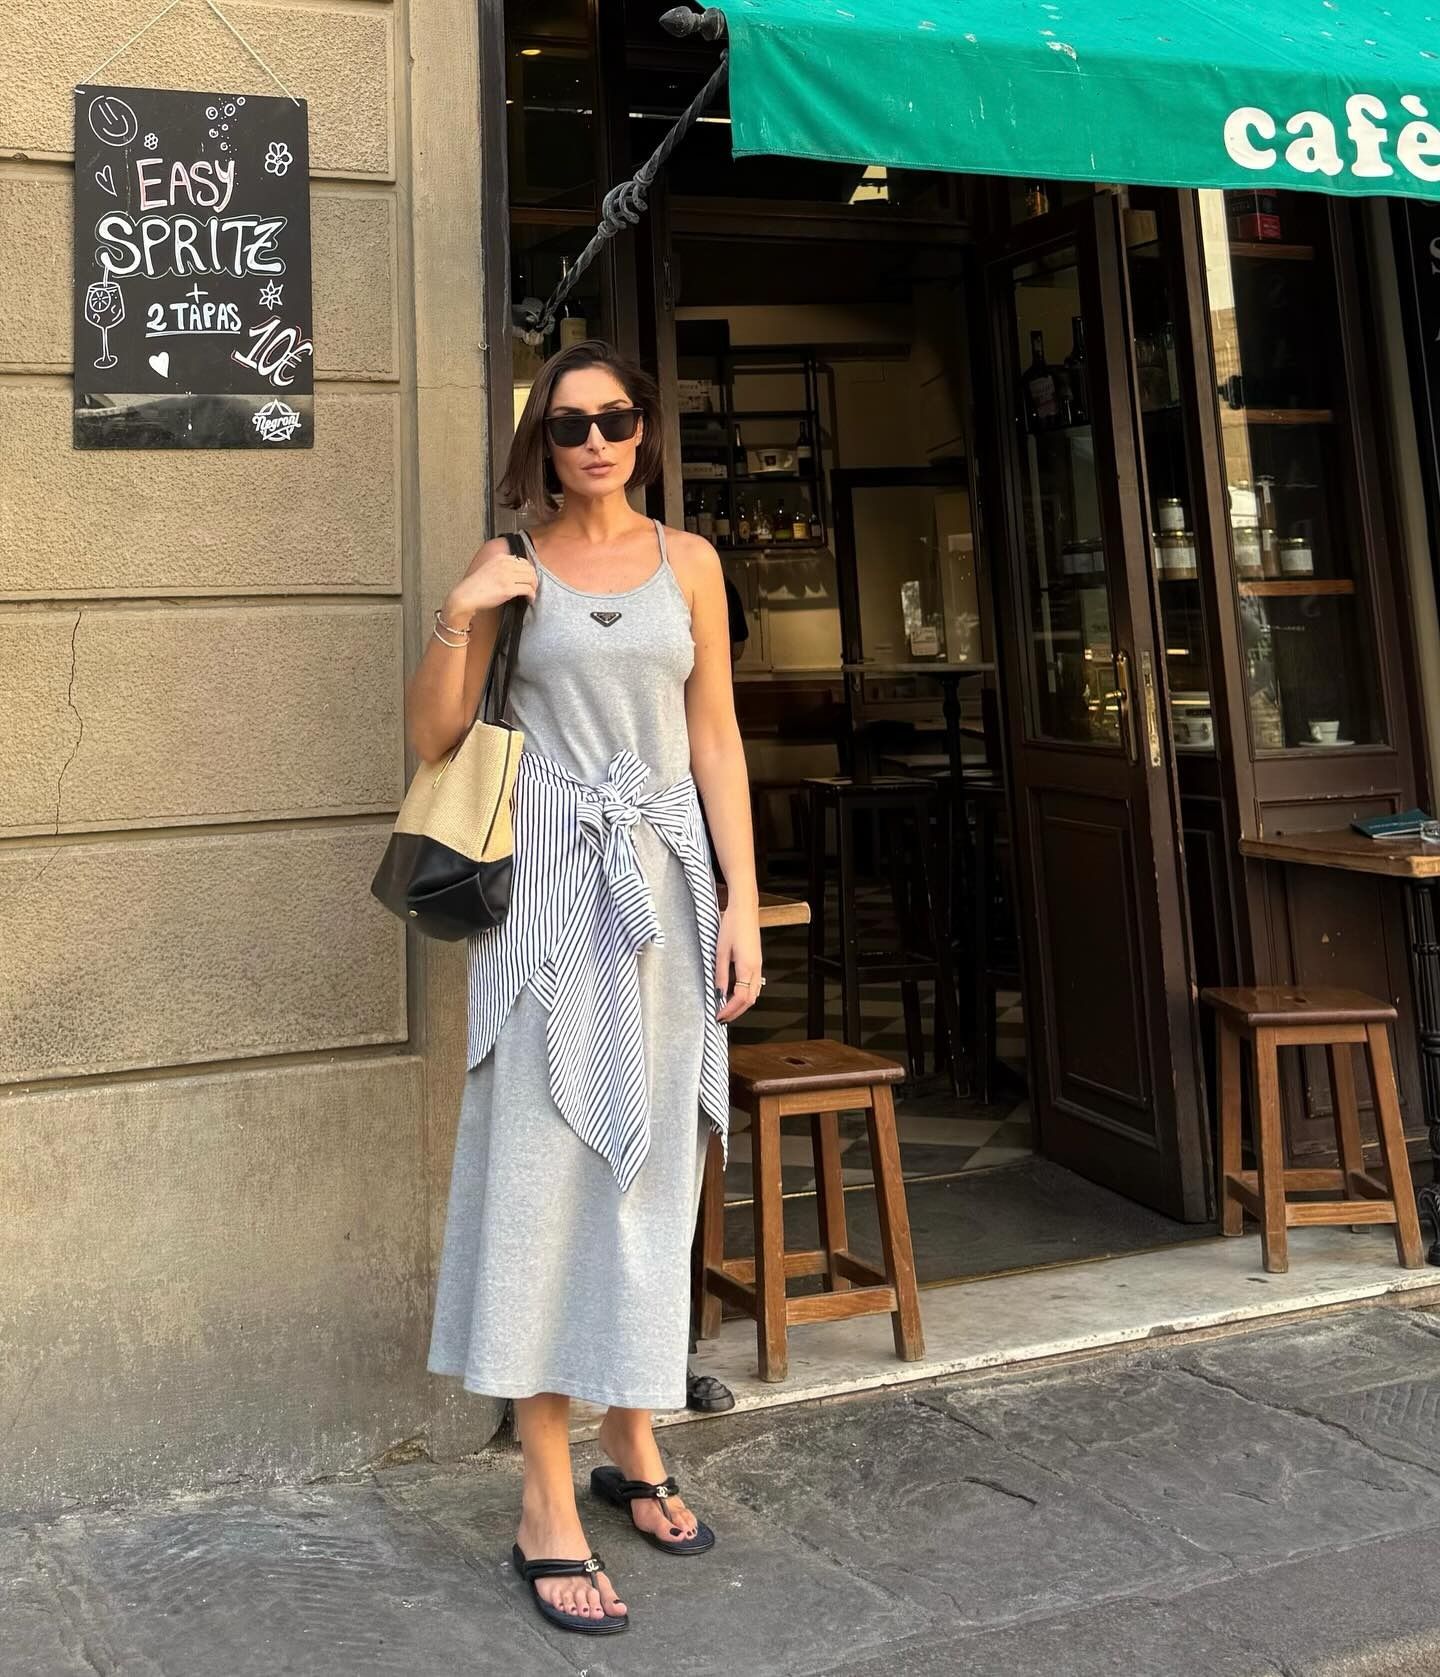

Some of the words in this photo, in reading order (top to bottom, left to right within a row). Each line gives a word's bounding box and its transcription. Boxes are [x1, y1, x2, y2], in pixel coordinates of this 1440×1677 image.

[1223, 94, 1440, 182] cafè
[136, 158, 235, 213] EASY
[98, 215, 284, 276] SPRITZ
[146, 303, 168, 331] 2
[169, 302, 242, 331] TAPAS
[234, 317, 313, 387] 10€
